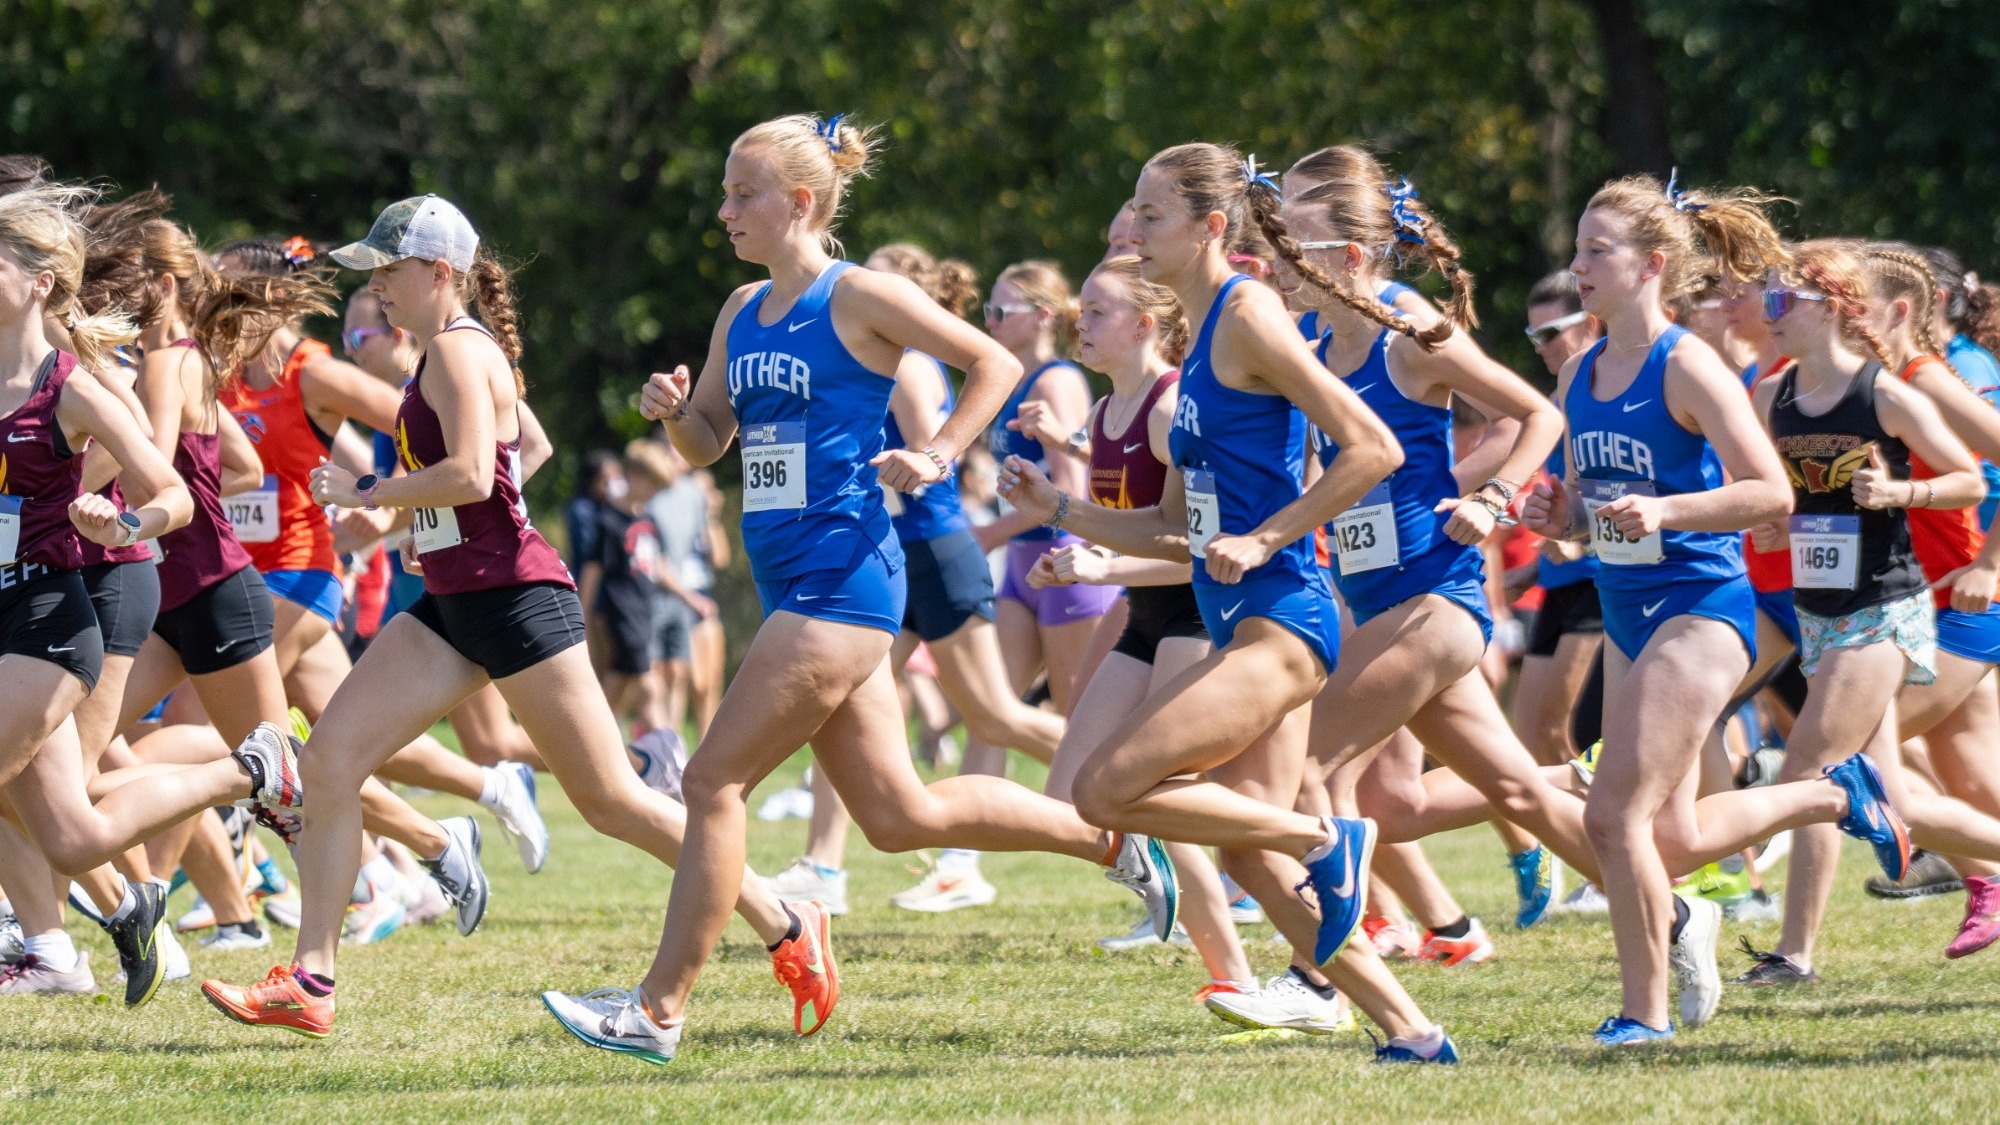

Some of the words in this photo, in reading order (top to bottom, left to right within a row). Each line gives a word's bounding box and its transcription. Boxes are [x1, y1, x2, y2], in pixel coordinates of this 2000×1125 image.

[729, 351, 811, 408] UTHER
[764, 447, 795, 457] Invitational
[1778, 434, 1863, 452] INNESOTA
[1573, 431, 1655, 481] UTHER
[414, 507, 438, 533] 70
[1346, 509, 1382, 522] Invitational
[1335, 522, 1376, 554] 1423
[1799, 546, 1839, 570] 1469
